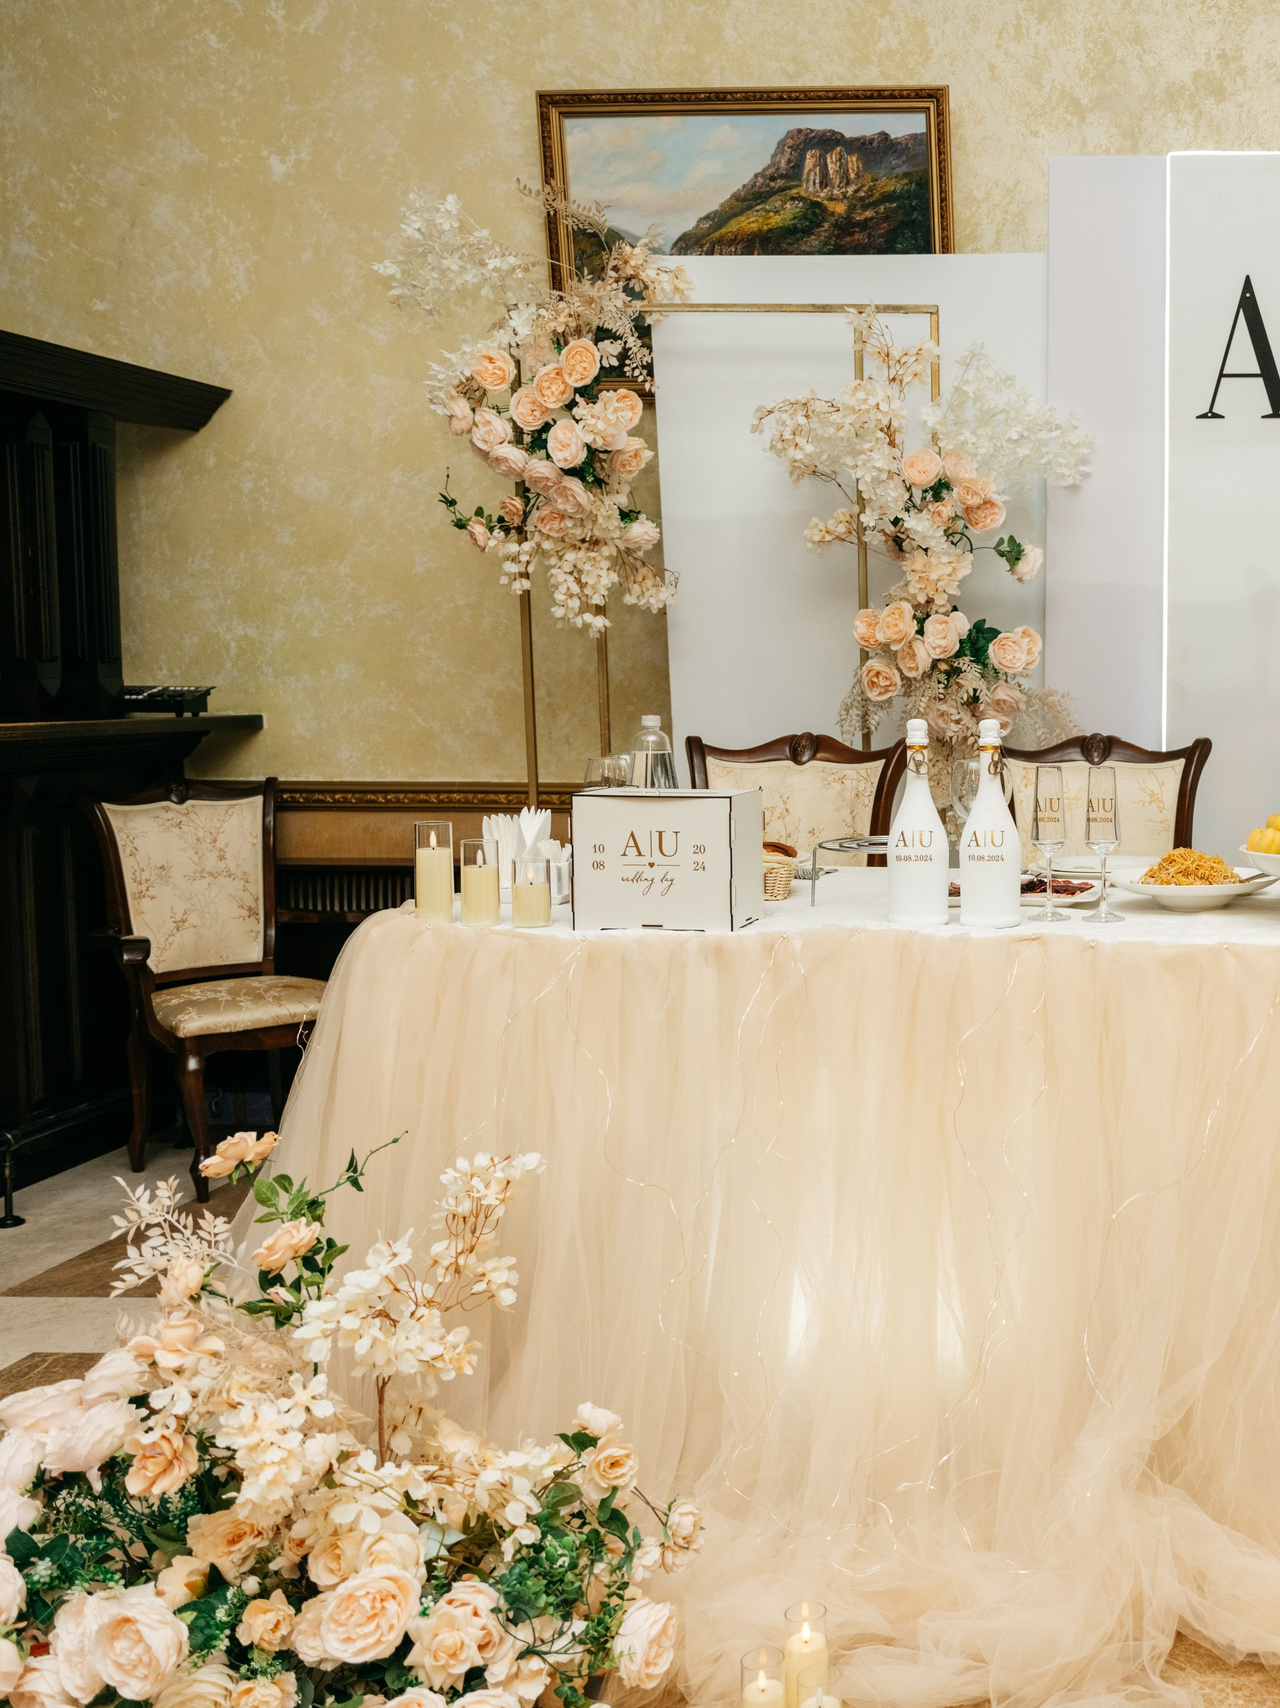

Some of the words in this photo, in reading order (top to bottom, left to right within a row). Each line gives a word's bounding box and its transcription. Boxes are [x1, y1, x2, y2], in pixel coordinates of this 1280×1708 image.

[592, 844, 605, 854] 10
[692, 844, 706, 855] 20
[592, 860, 606, 871] 08
[693, 861, 706, 872] 24
[621, 871, 655, 896] wedding
[660, 871, 675, 897] day
